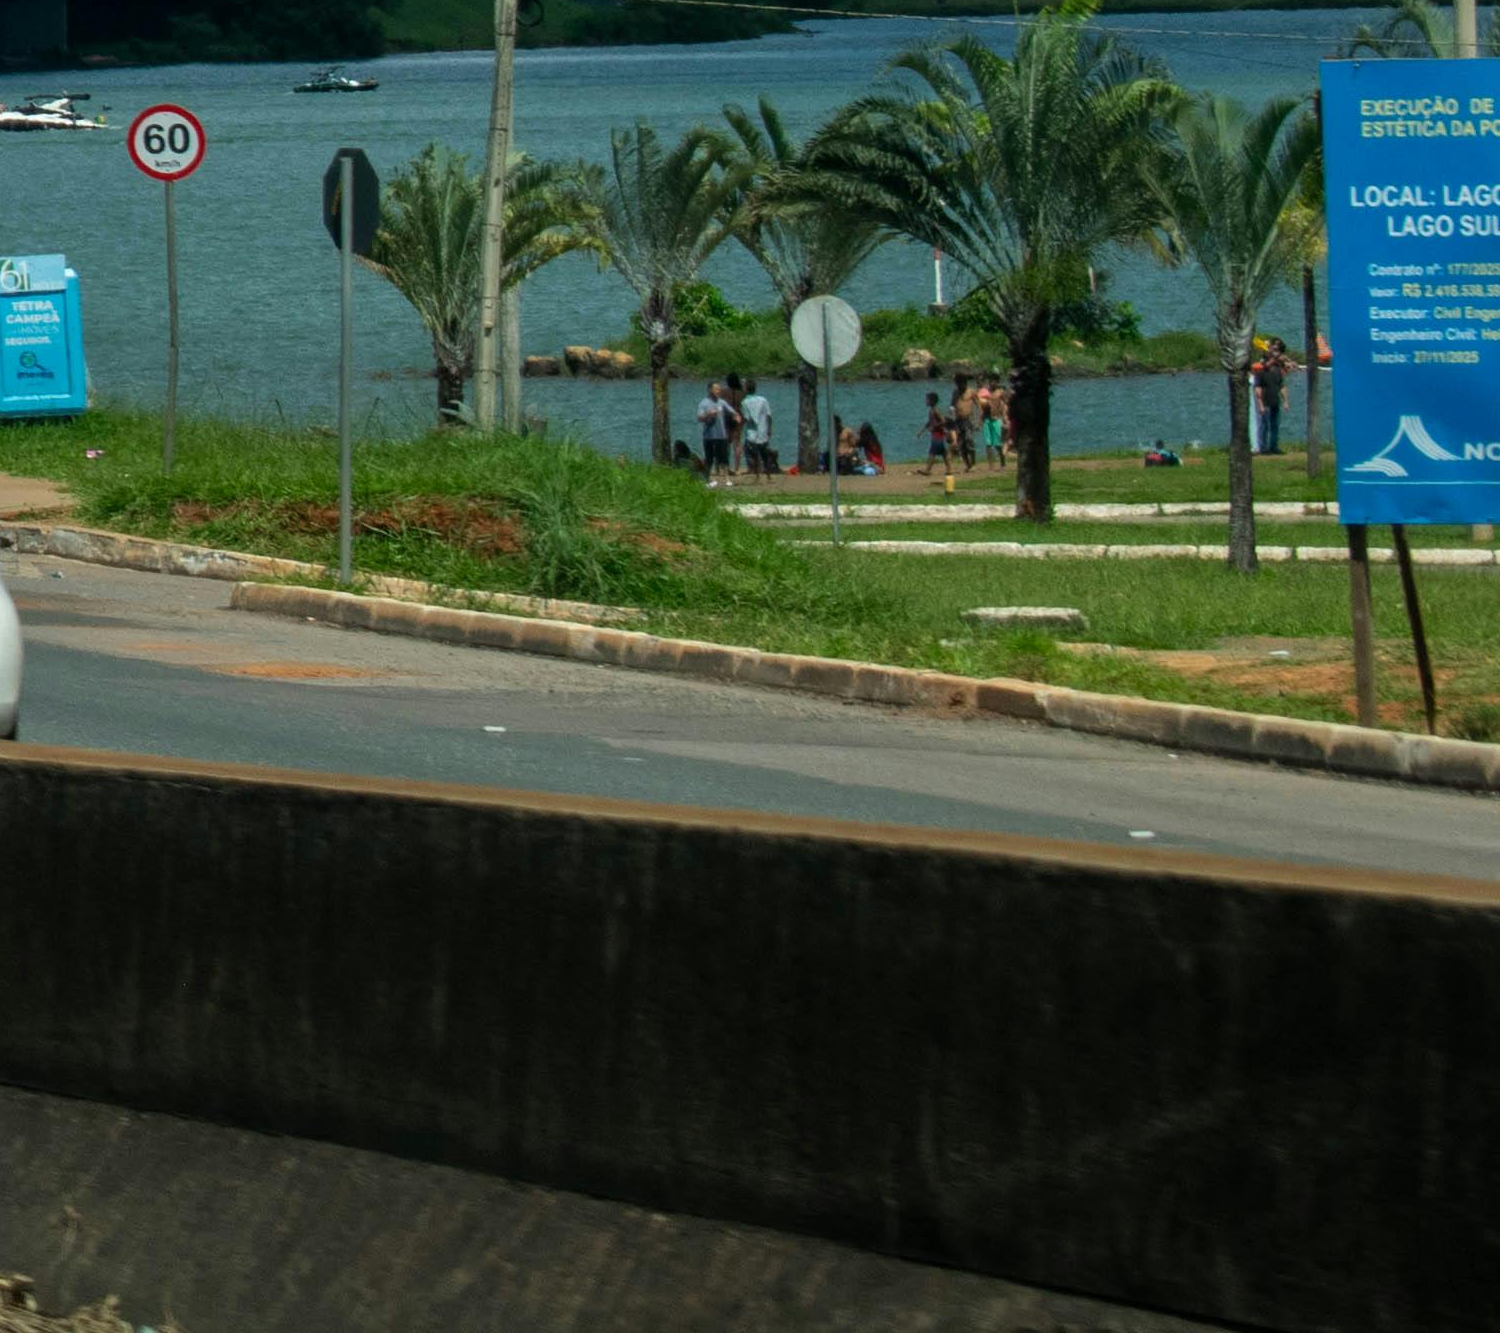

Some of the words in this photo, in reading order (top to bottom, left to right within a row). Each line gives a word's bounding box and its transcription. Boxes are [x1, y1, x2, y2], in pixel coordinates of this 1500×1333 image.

[1360, 96, 1460, 117] EXECUÇÃO
[1469, 97, 1495, 115] DE
[143, 123, 190, 154] 60
[1361, 118, 1448, 138] ESTÉTICA
[1450, 120, 1477, 137] DA
[1349, 185, 1436, 208] LOCAL:
[1388, 214, 1455, 238] LAGO
[11, 300, 54, 311] TETRA
